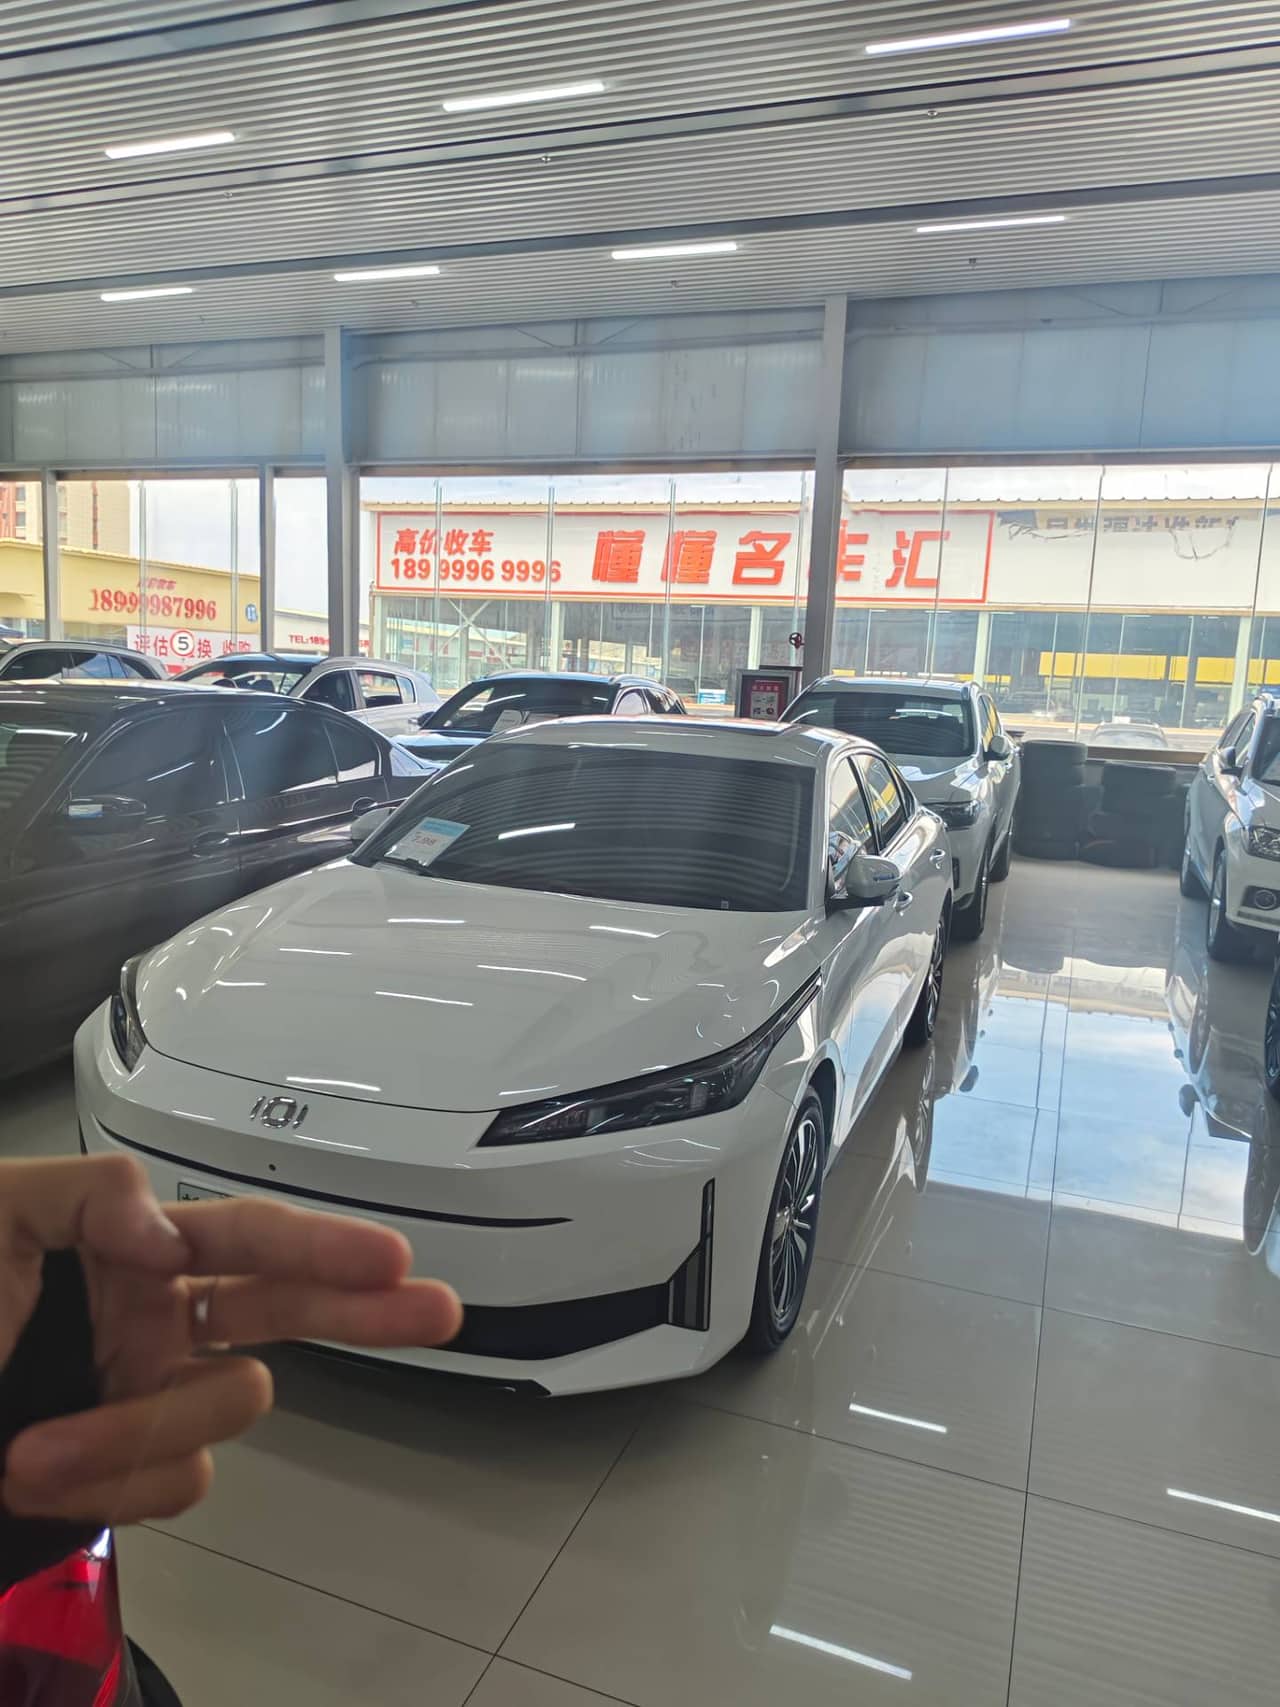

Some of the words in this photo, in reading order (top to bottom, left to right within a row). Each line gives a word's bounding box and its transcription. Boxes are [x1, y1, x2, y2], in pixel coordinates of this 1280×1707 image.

[393, 528, 494, 557] 高价收车
[391, 558, 431, 580] 189
[439, 559, 495, 582] 9996
[501, 560, 562, 583] 9996
[178, 636, 190, 651] 5
